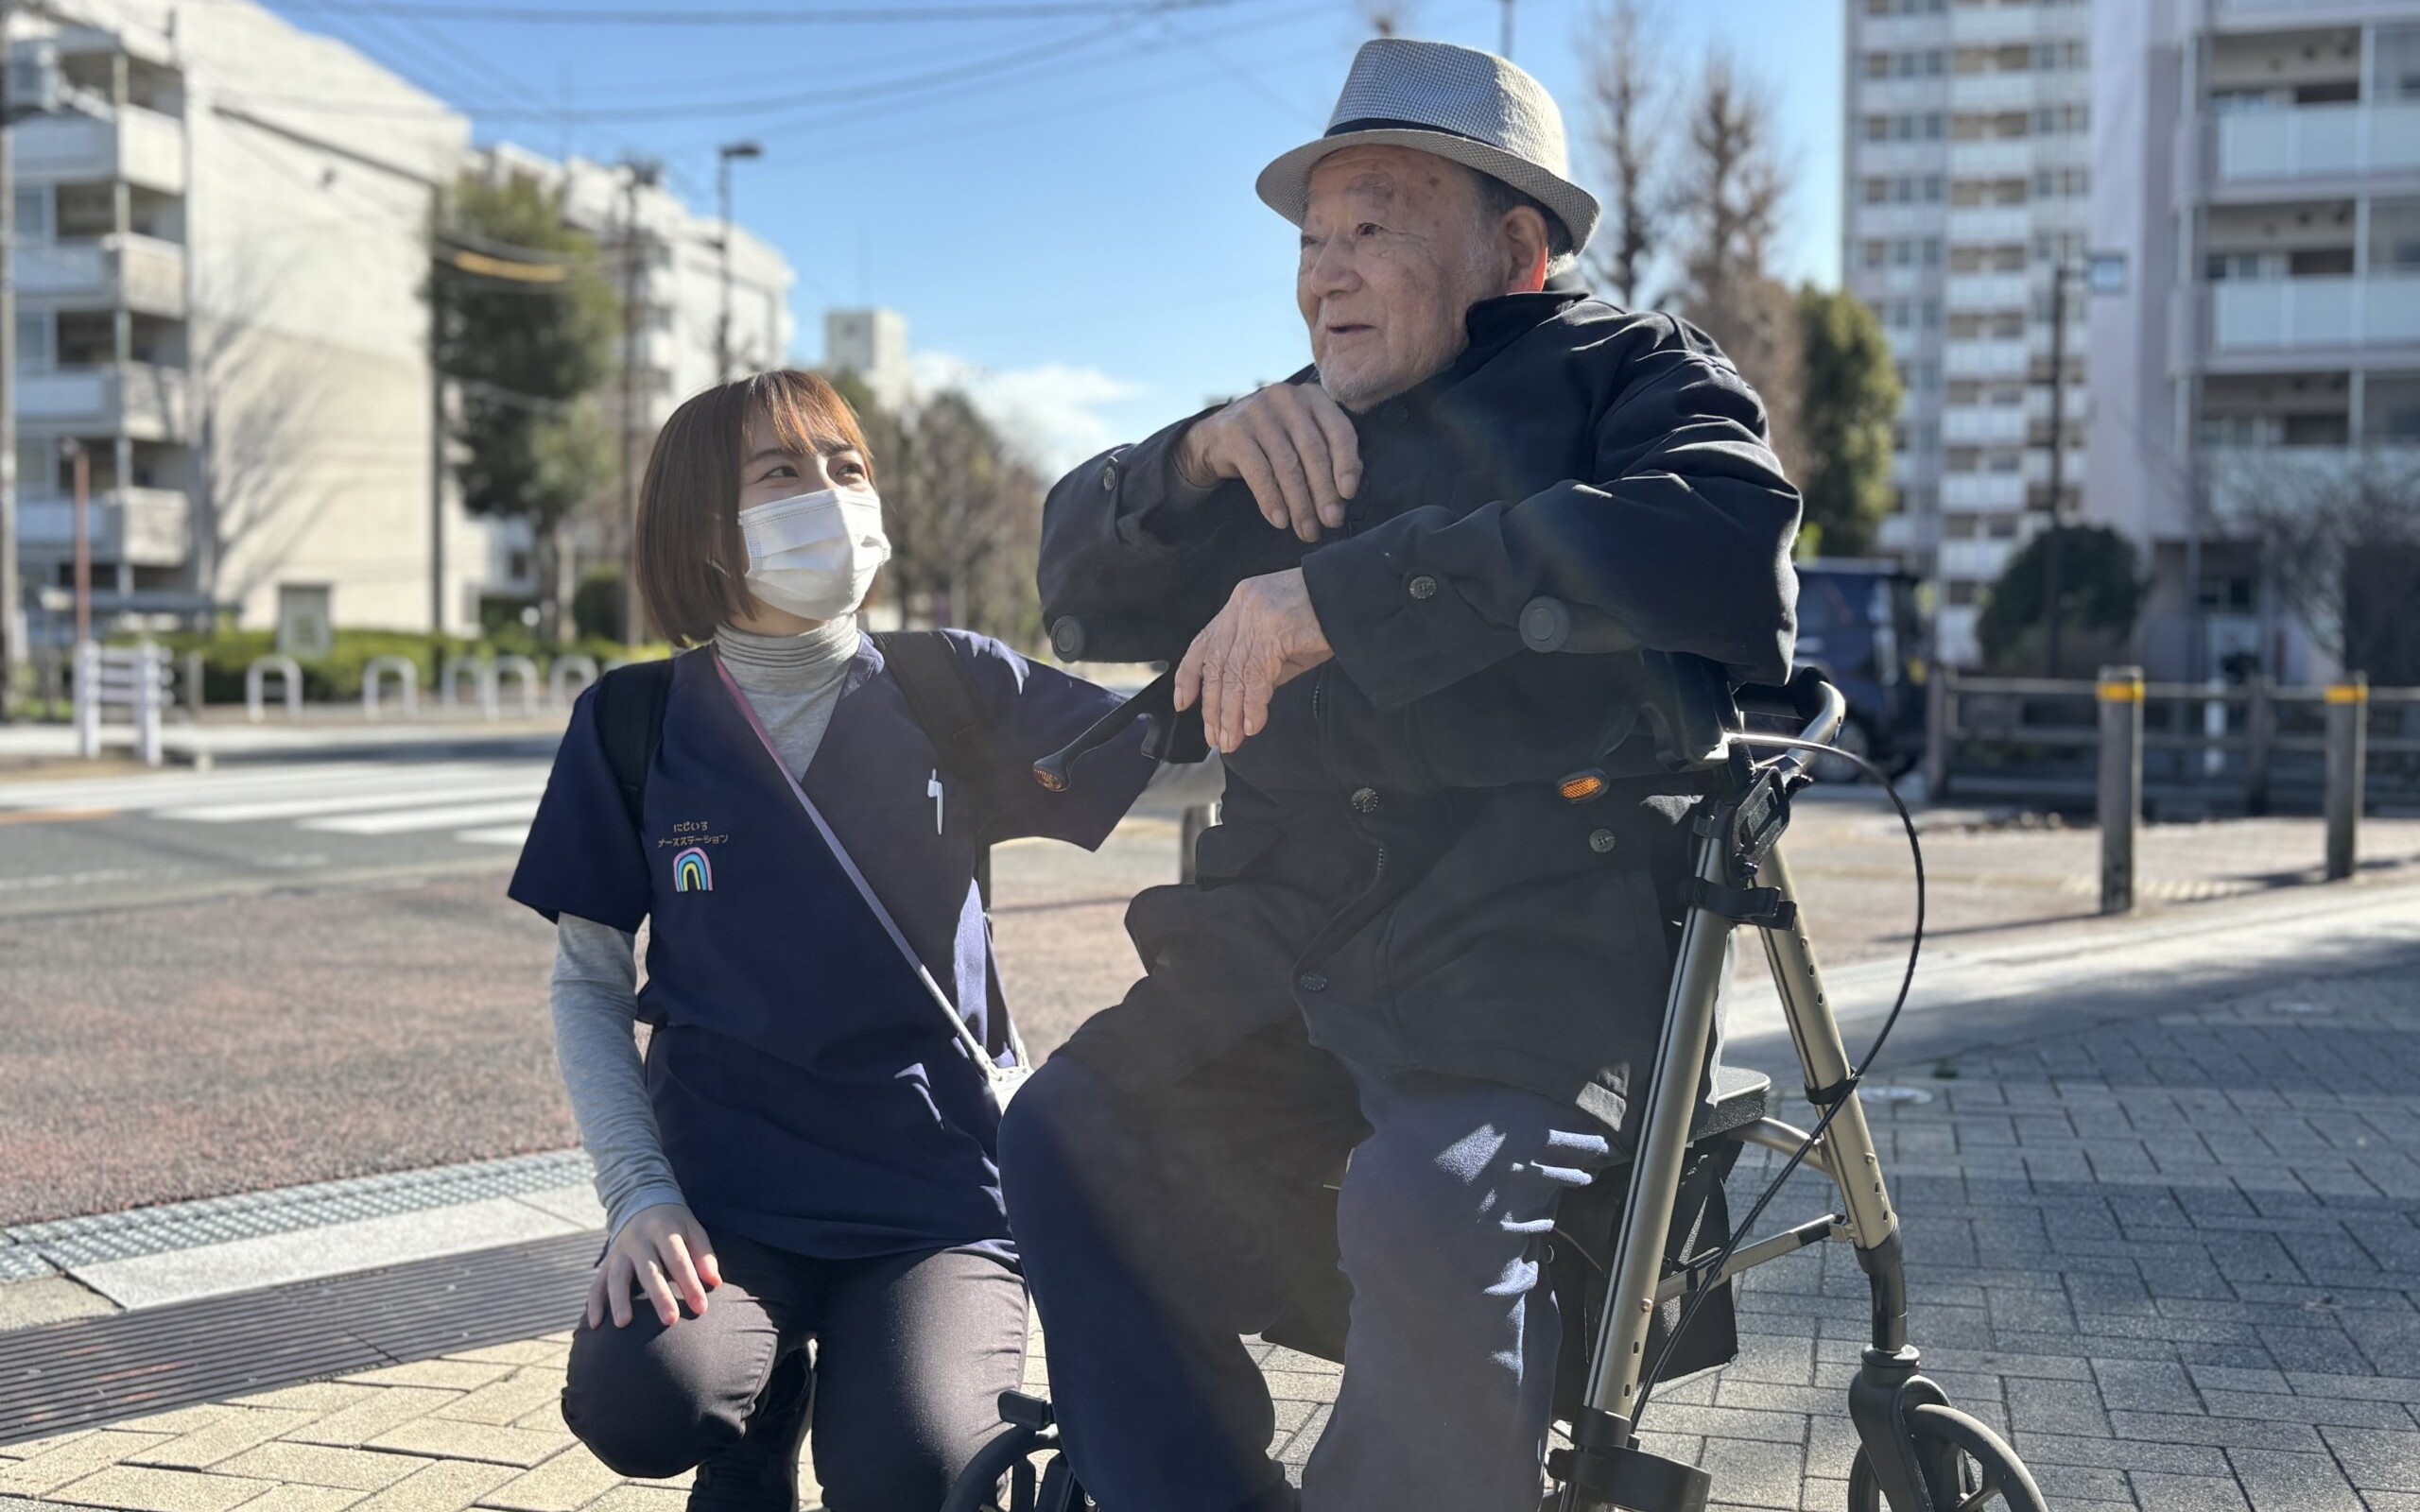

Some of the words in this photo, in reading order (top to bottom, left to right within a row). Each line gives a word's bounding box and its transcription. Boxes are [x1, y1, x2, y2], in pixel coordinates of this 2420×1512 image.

[673, 821, 708, 833] にじいろ
[658, 834, 729, 849] ナースステーション
